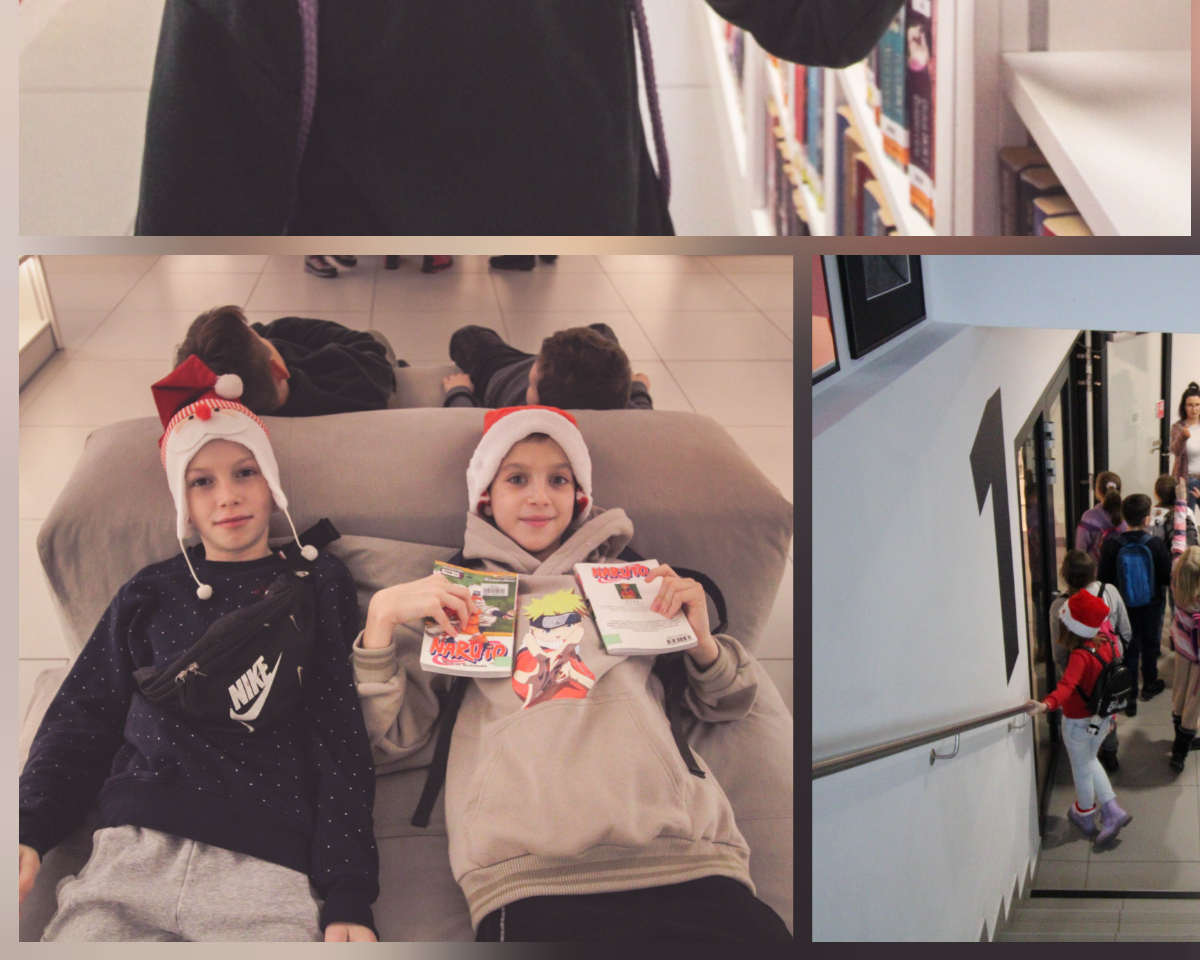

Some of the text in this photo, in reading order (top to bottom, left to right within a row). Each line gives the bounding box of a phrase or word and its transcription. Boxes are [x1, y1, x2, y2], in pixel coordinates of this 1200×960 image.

[591, 565, 650, 580] NARUTO
[430, 637, 508, 664] NARUTO
[228, 655, 273, 711] NIKE
